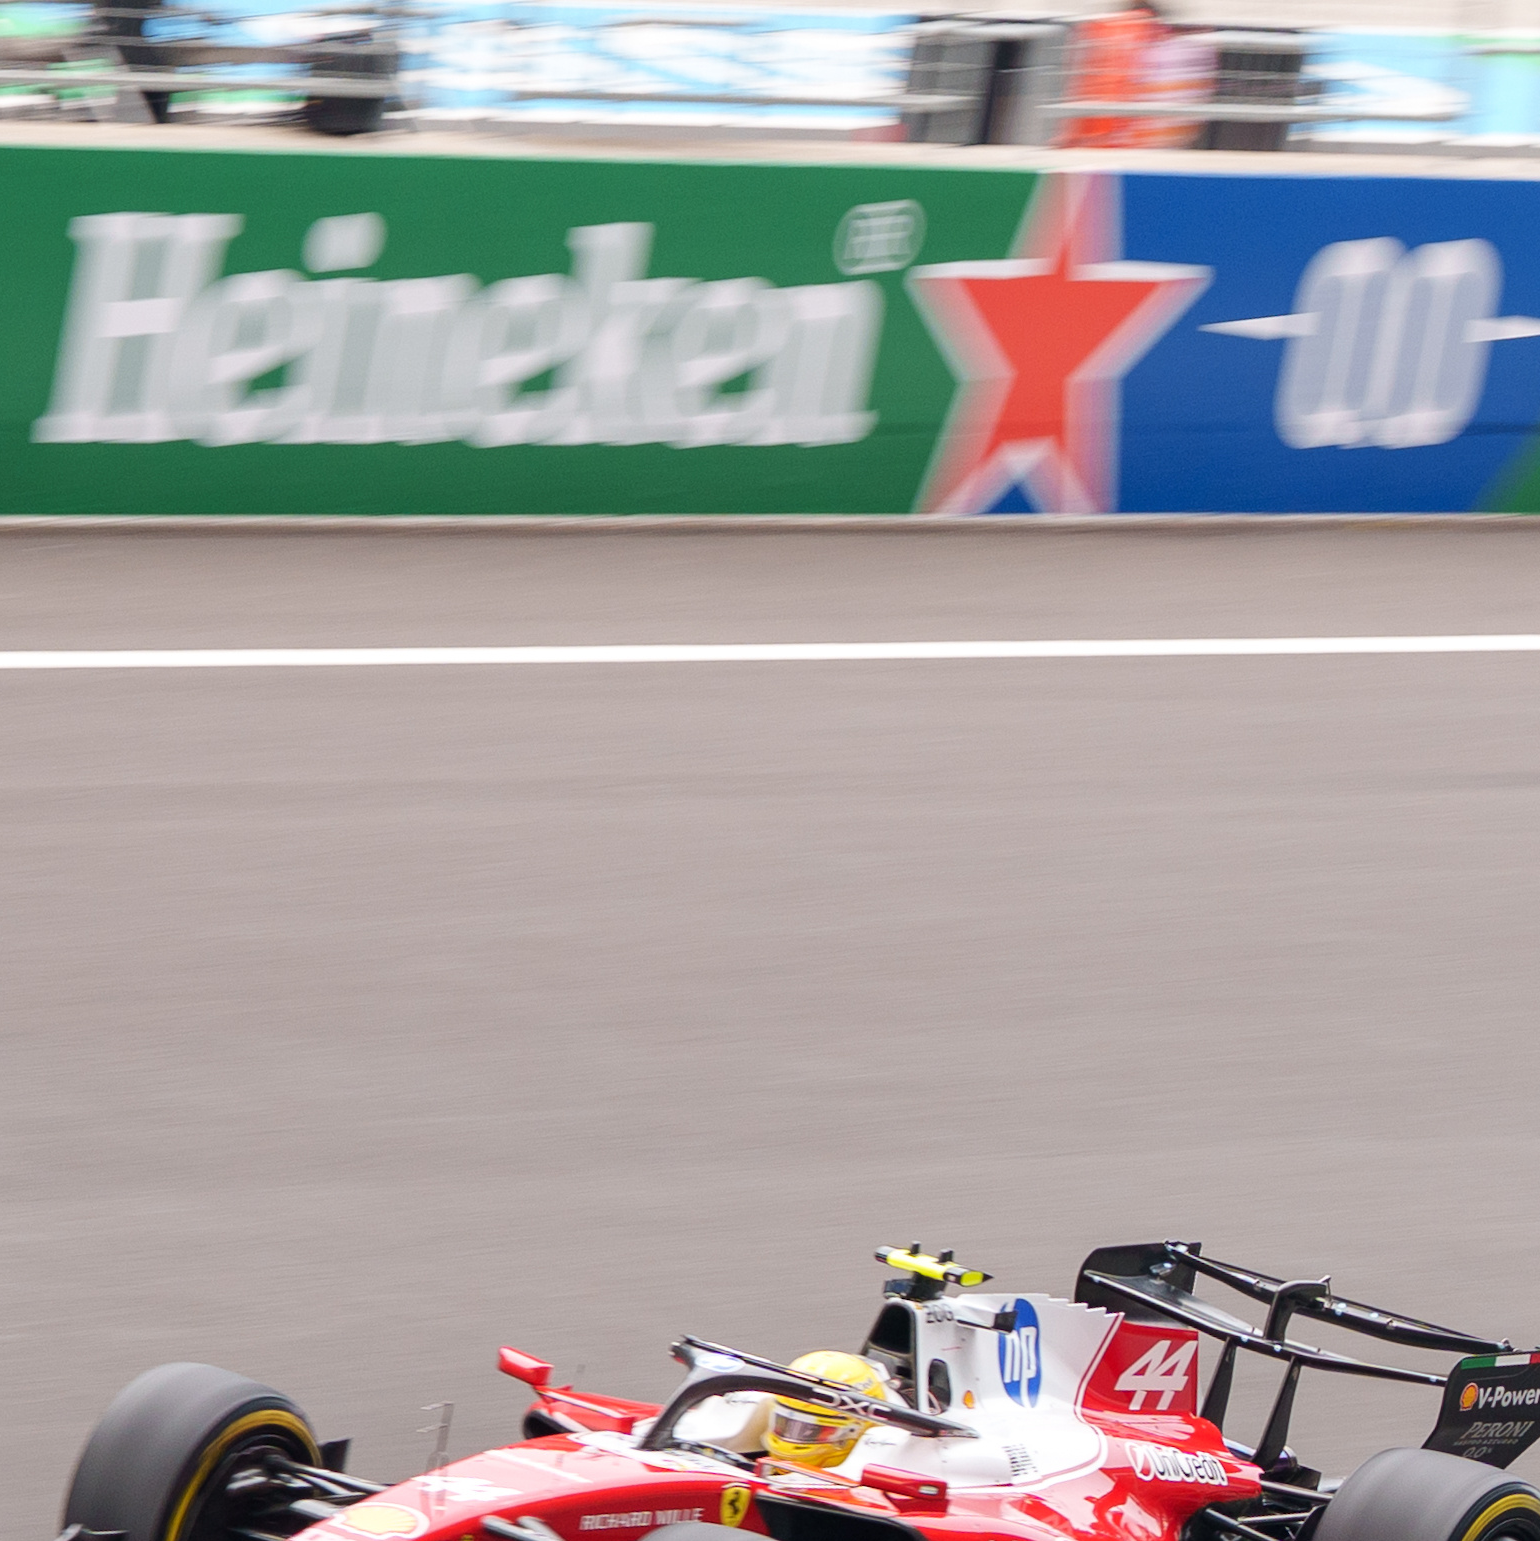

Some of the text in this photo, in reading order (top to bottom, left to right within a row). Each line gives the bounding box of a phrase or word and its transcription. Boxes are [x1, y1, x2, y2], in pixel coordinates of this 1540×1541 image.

[29, 210, 885, 448] Heineken
[1114, 1339, 1199, 1411] 44
[808, 1386, 893, 1421] DXC
[1460, 1421, 1535, 1439] PERONI
[1149, 1446, 1229, 1487] UniCredit
[579, 1511, 653, 1530] RICHARD
